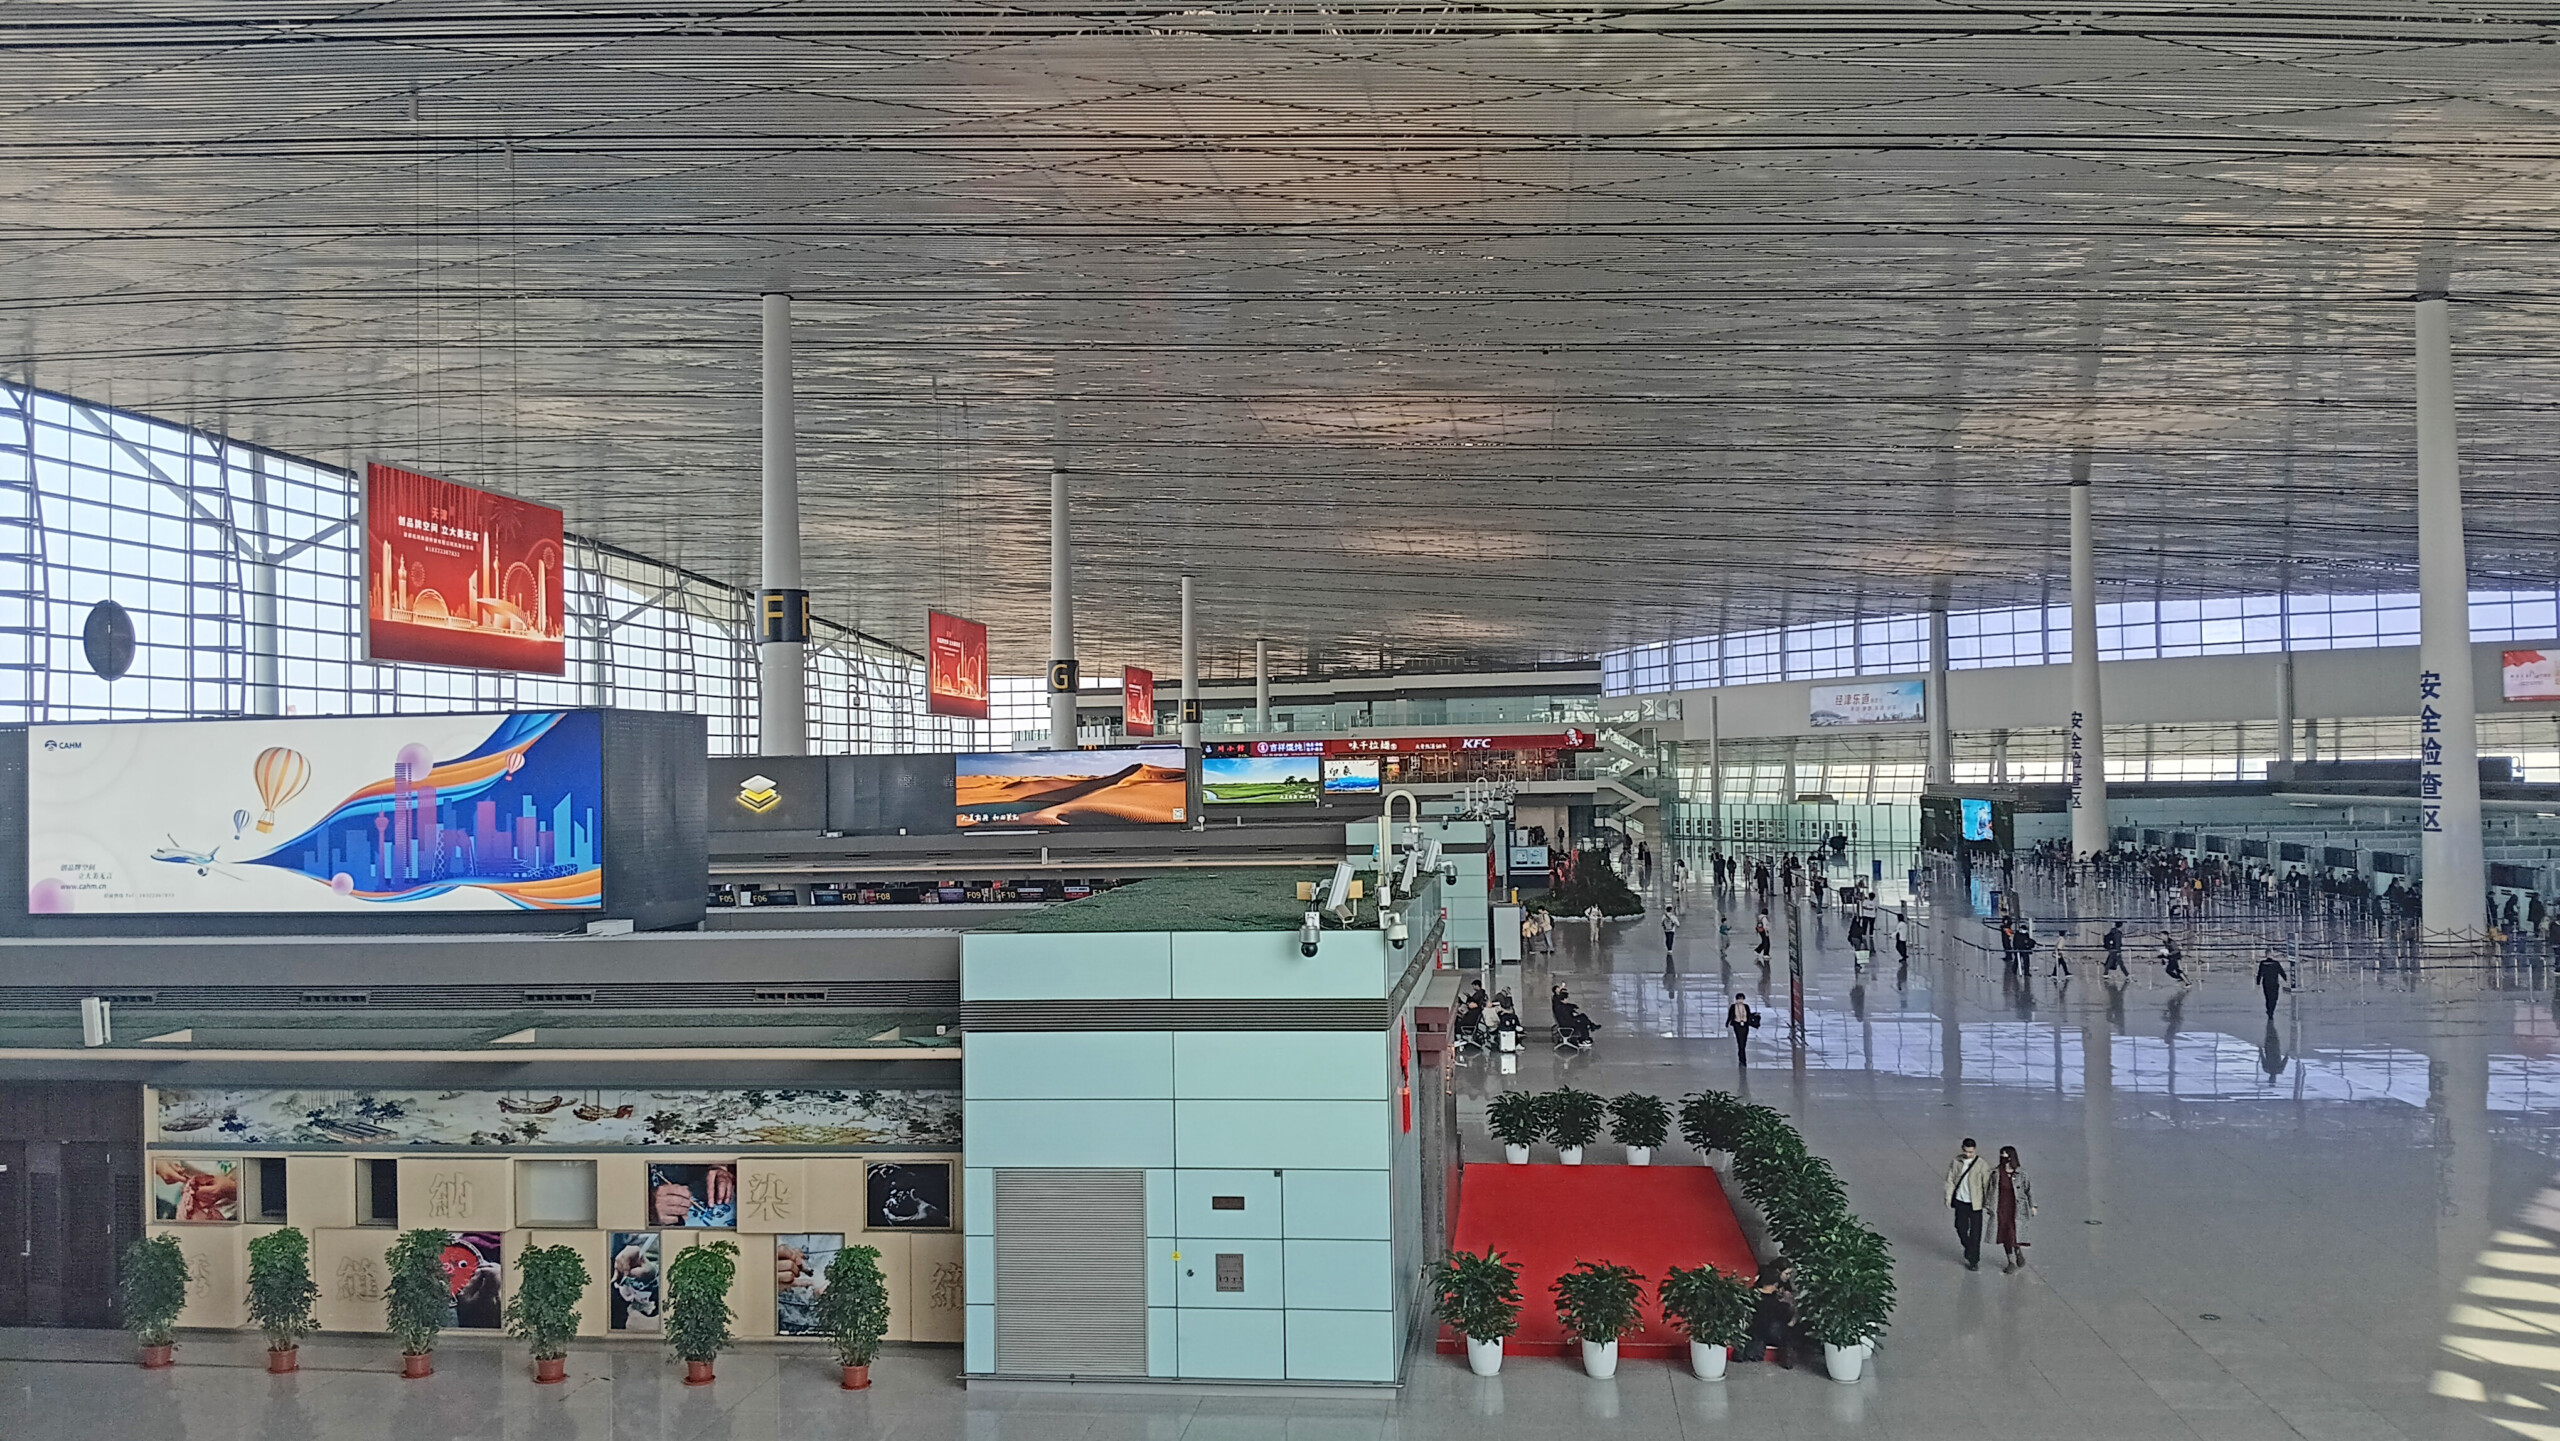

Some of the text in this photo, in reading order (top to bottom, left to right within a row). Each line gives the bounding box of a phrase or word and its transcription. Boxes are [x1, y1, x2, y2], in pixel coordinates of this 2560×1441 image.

[398, 515, 479, 542] 创品牌空间 立大美无言
[763, 595, 784, 637] F
[1051, 664, 1068, 689] G
[1183, 701, 1196, 720] H
[59, 741, 82, 749] CAHM
[1462, 738, 1492, 748] KFC
[2420, 670, 2443, 832] 安全检查区
[2071, 711, 2083, 809] 安全检查区
[719, 895, 734, 903] F05
[753, 895, 768, 903] F06
[842, 893, 857, 901] F07
[876, 893, 891, 901] F08
[966, 891, 981, 899] F09
[1001, 891, 1016, 899] F10
[745, 1172, 791, 1221] 染
